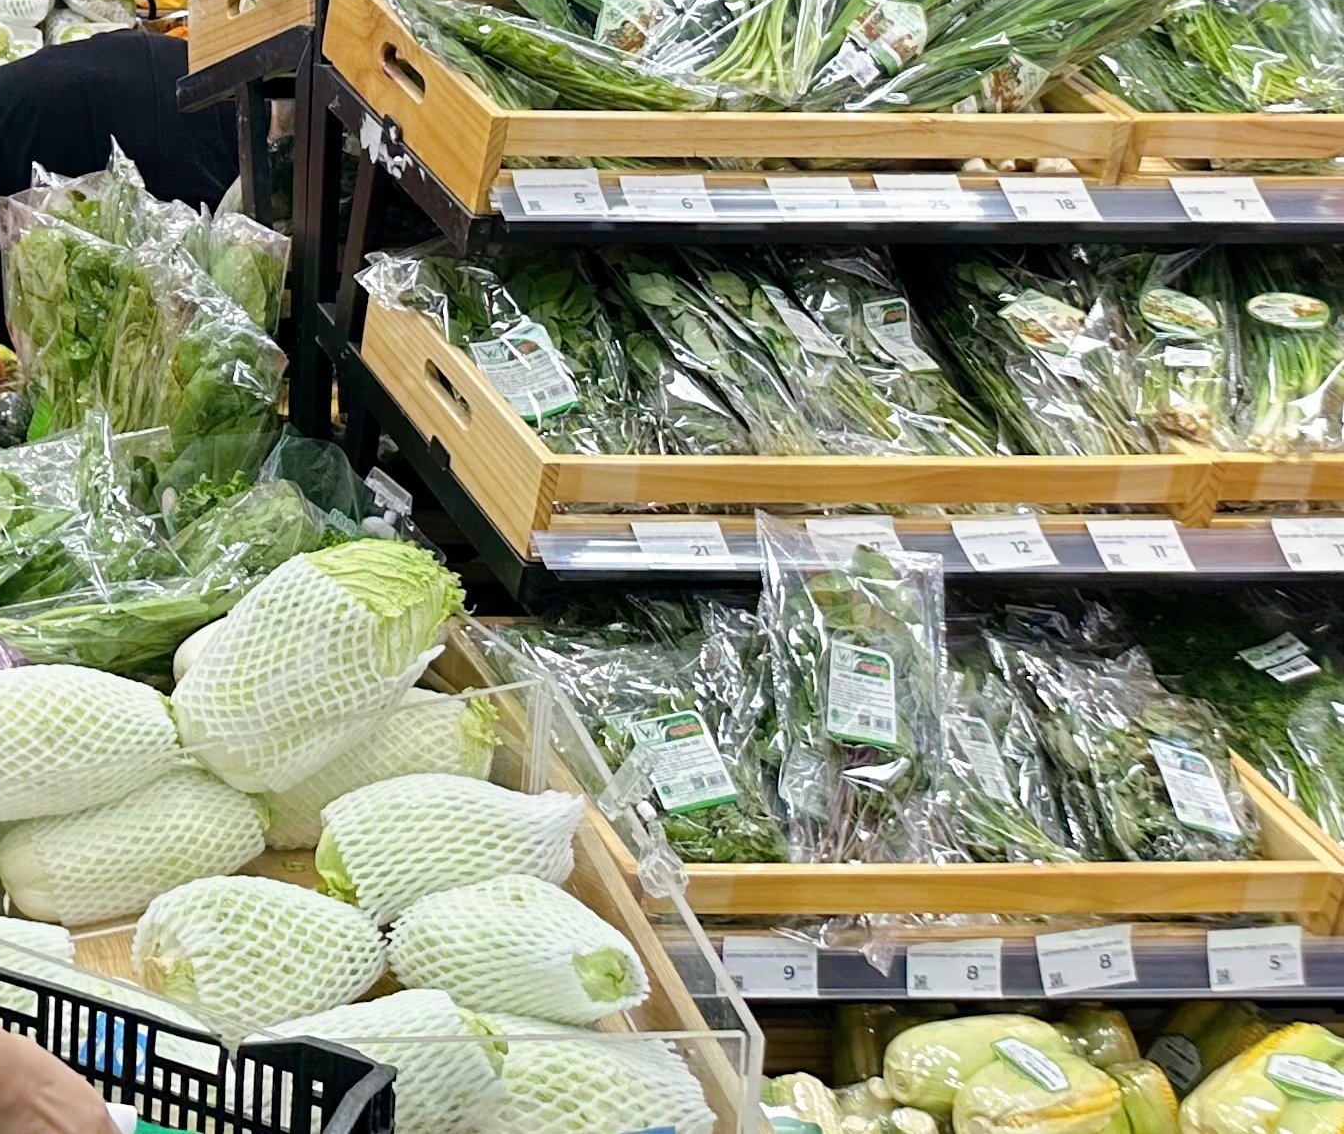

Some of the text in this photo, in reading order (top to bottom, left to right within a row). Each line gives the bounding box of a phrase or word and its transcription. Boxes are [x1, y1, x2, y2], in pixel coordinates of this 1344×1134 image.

[575, 192, 586, 204] 5
[681, 197, 693, 210] 6
[1055, 198, 1076, 211] 18
[1234, 199, 1246, 211] 7
[690, 545, 710, 557] 21
[1010, 540, 1032, 554] 12
[1150, 544, 1168, 558] 11
[1099, 954, 1111, 970] 8
[1269, 955, 1281, 970] 5
[783, 965, 795, 981] 9
[966, 965, 978, 981] 8
